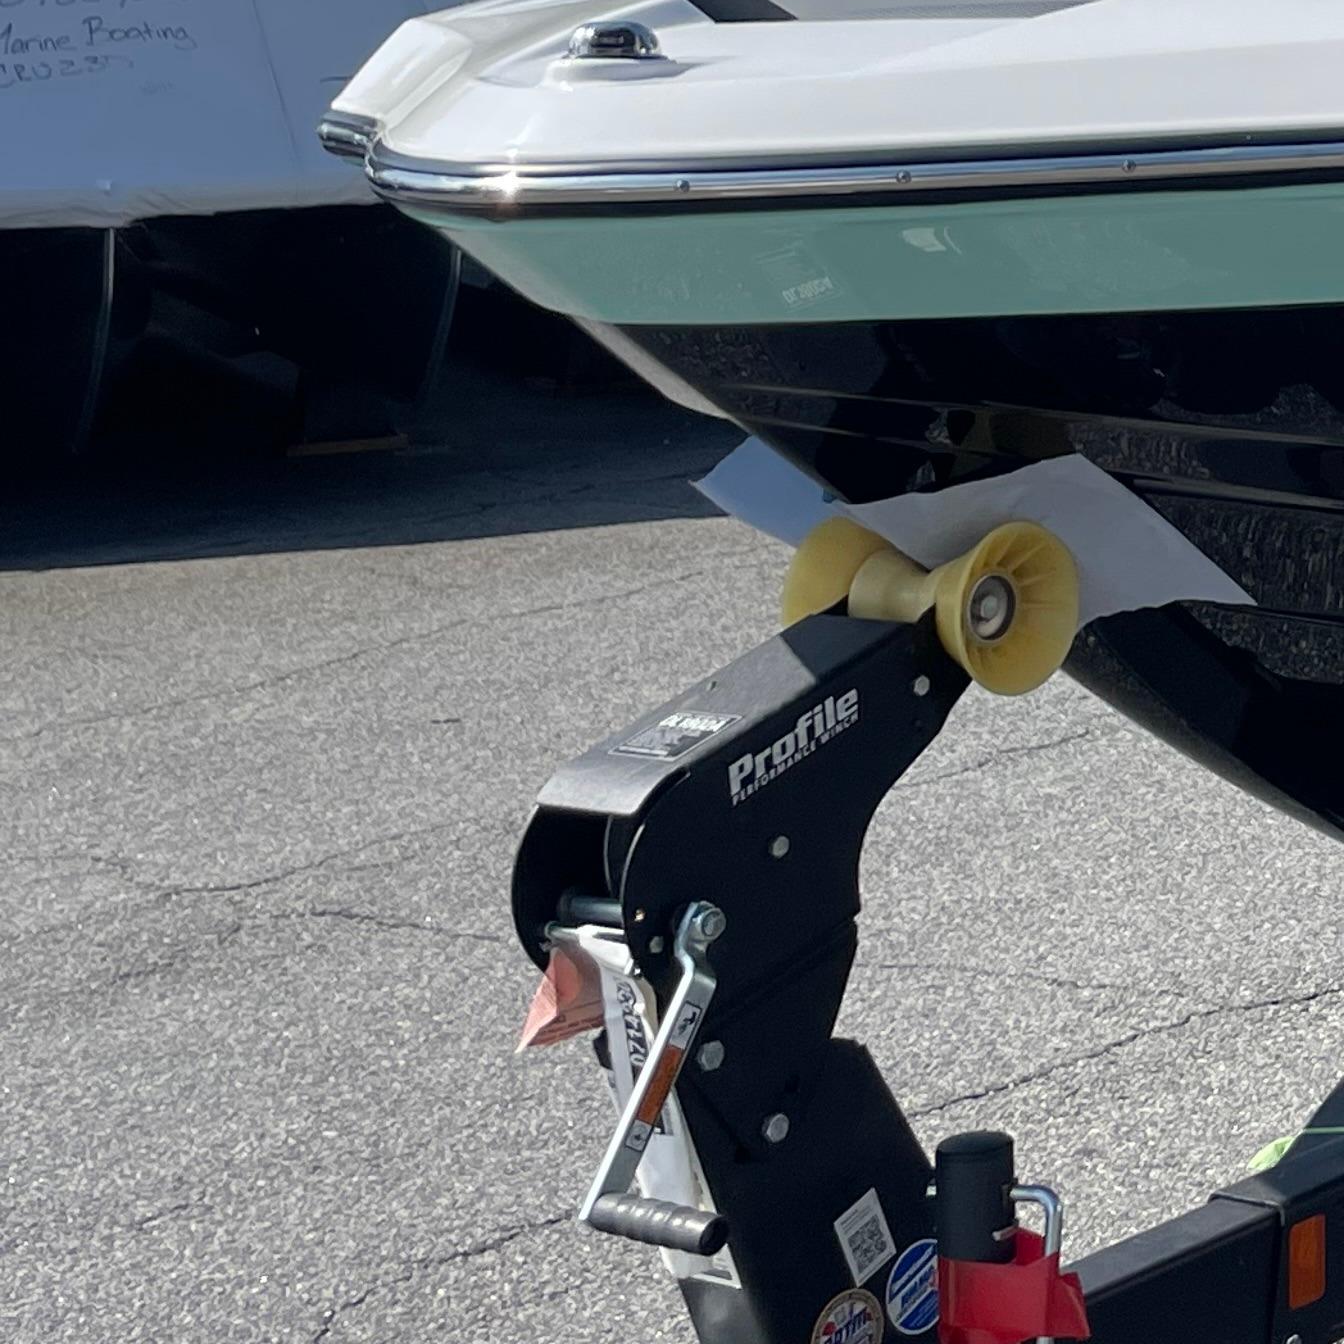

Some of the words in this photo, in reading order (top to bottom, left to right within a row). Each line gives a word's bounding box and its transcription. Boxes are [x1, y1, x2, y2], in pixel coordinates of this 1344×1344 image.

[82, 15, 198, 51] Boating
[728, 688, 859, 797] Profile
[732, 738, 817, 806] PERFORMANCE
[820, 710, 859, 744] WINCH
